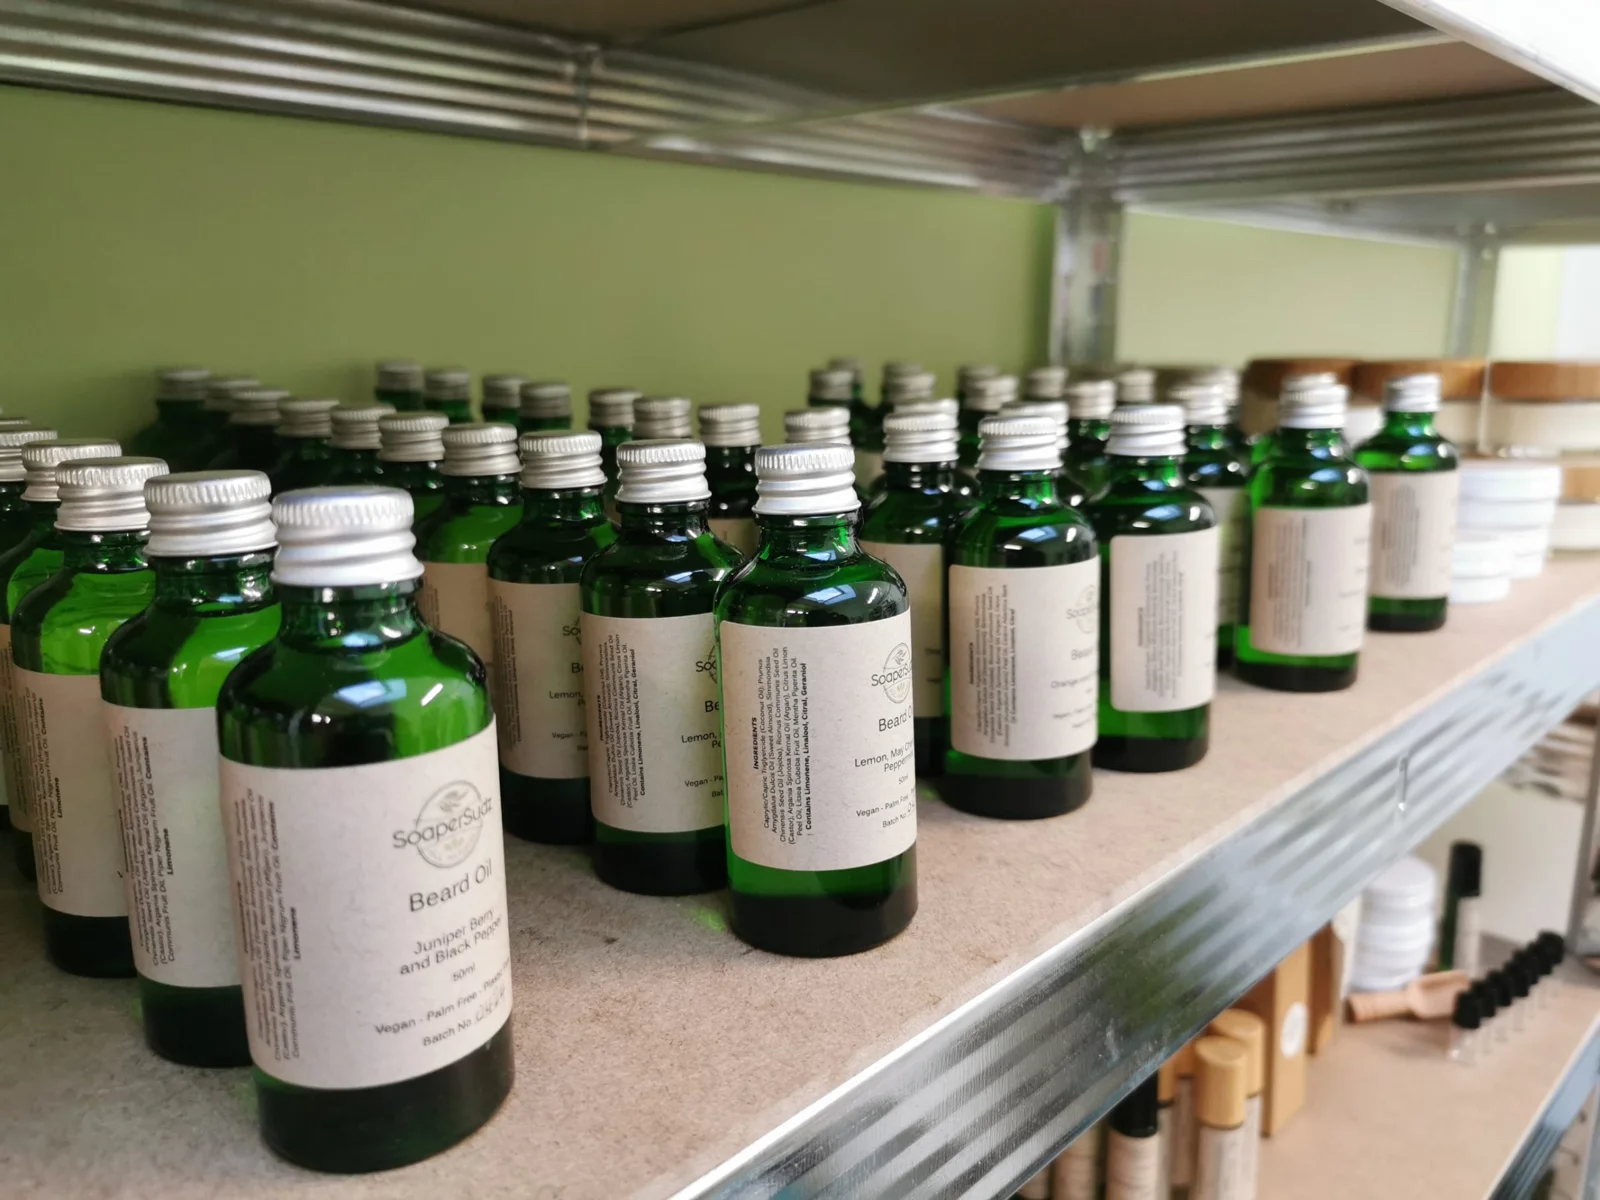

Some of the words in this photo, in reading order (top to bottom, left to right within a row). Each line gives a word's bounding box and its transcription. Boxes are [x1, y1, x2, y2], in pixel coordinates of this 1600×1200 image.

[878, 710, 907, 732] Beard
[142, 736, 152, 779] Contains
[854, 755, 889, 767] Lemon,
[891, 748, 903, 758] May
[392, 797, 492, 848] SoaperSudz
[856, 807, 879, 817] Vegan
[885, 800, 899, 809] Palm
[882, 817, 900, 828] Batch
[409, 873, 470, 912] Beard
[475, 858, 492, 884] Oil
[413, 926, 467, 955] Juniper
[400, 956, 431, 975] and
[435, 940, 471, 963] Black
[375, 1019, 416, 1034] Vegan
[427, 1004, 455, 1020] Palm
[458, 992, 477, 1008] Free
[423, 1028, 455, 1046] Batch
